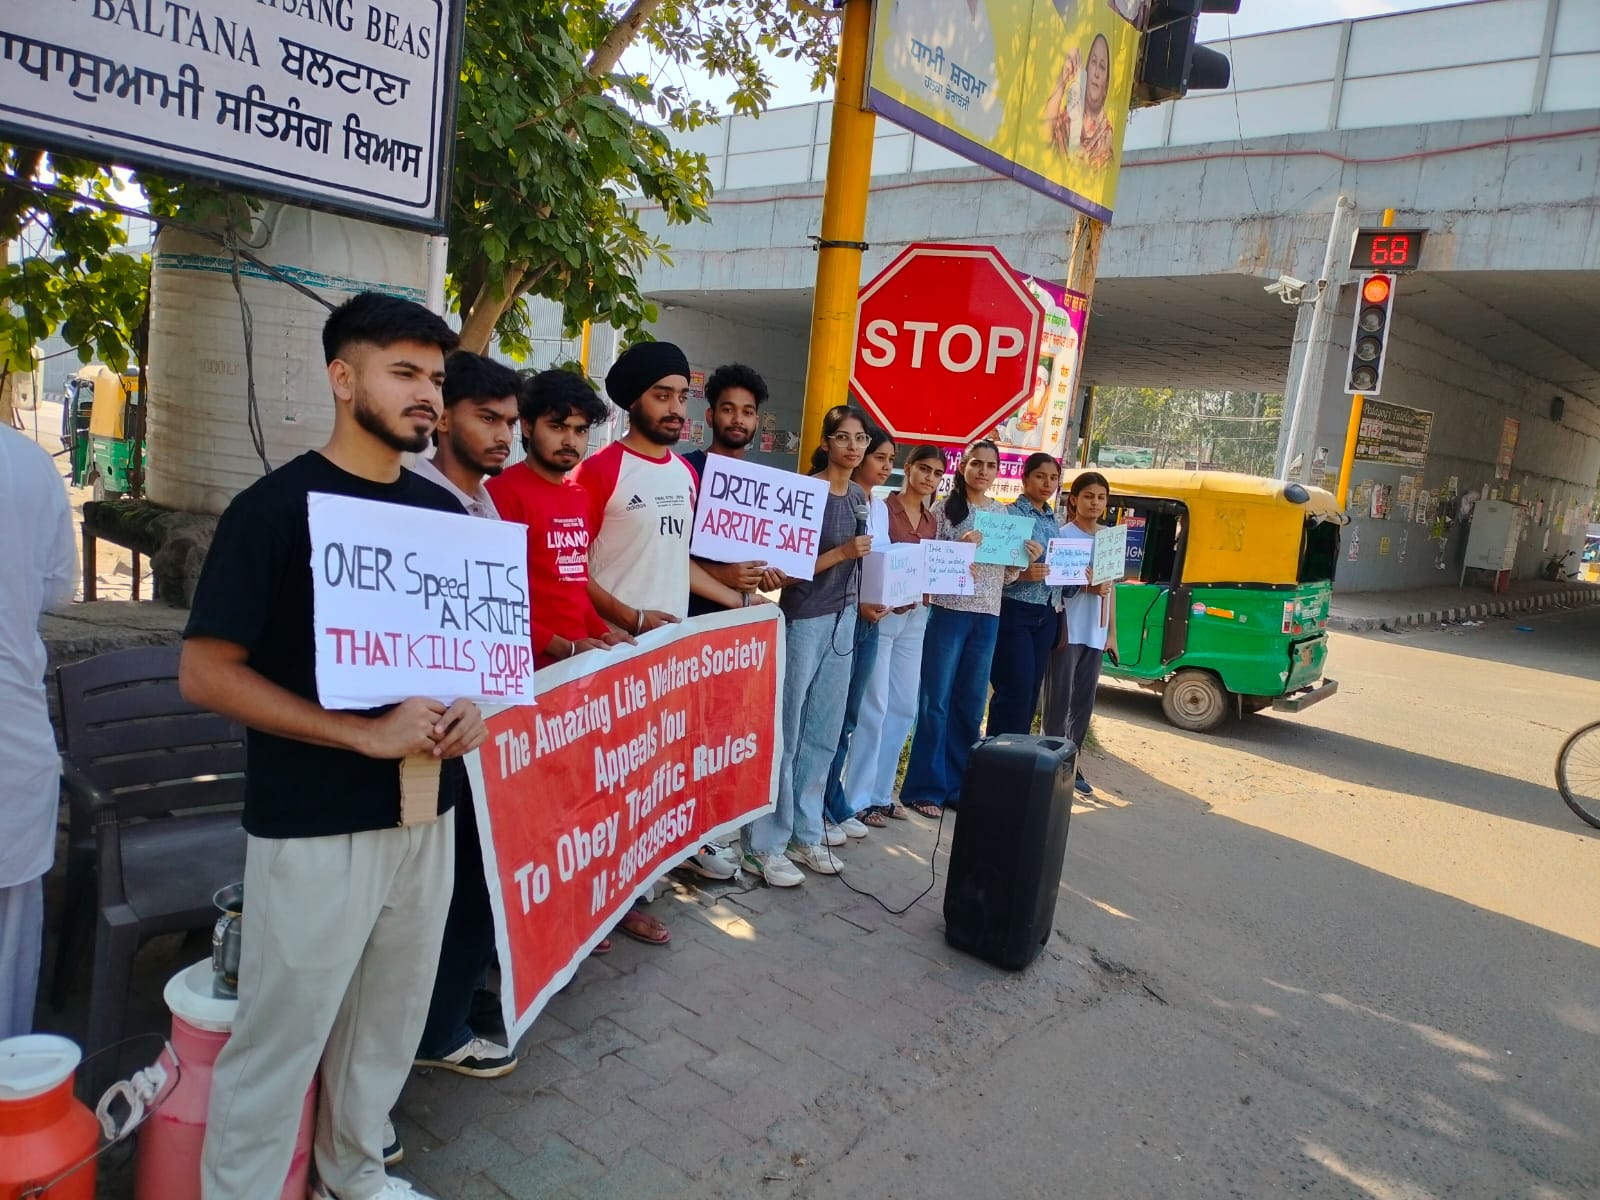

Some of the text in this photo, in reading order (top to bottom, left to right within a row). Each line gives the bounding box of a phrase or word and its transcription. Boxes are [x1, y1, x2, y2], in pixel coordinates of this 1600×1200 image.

[91, 0, 410, 105] BALTANA ਬਲਟਾਣਾ
[365, 5, 431, 59] BEAS
[0, 31, 423, 178] ਾਧਾਸੁਆਮੀ ਸਤਿਸੰਗ ਬਿਆਸ
[1370, 235, 1409, 265] 68
[861, 319, 1025, 374] STOP
[710, 471, 815, 521] DRIVE SAFE
[660, 515, 684, 539] Fly
[701, 507, 817, 556] ARRIVE SAFE
[324, 542, 525, 610] OVER Speed IS
[440, 599, 531, 637] A KNIFE
[325, 628, 530, 677] THAT KILLS YOUR
[481, 672, 525, 697] LIFE
[496, 636, 767, 779] The Amazing Life Welfare Society
[594, 709, 686, 794] Appeals You
[514, 733, 757, 915] To Obey Traffic Rules
